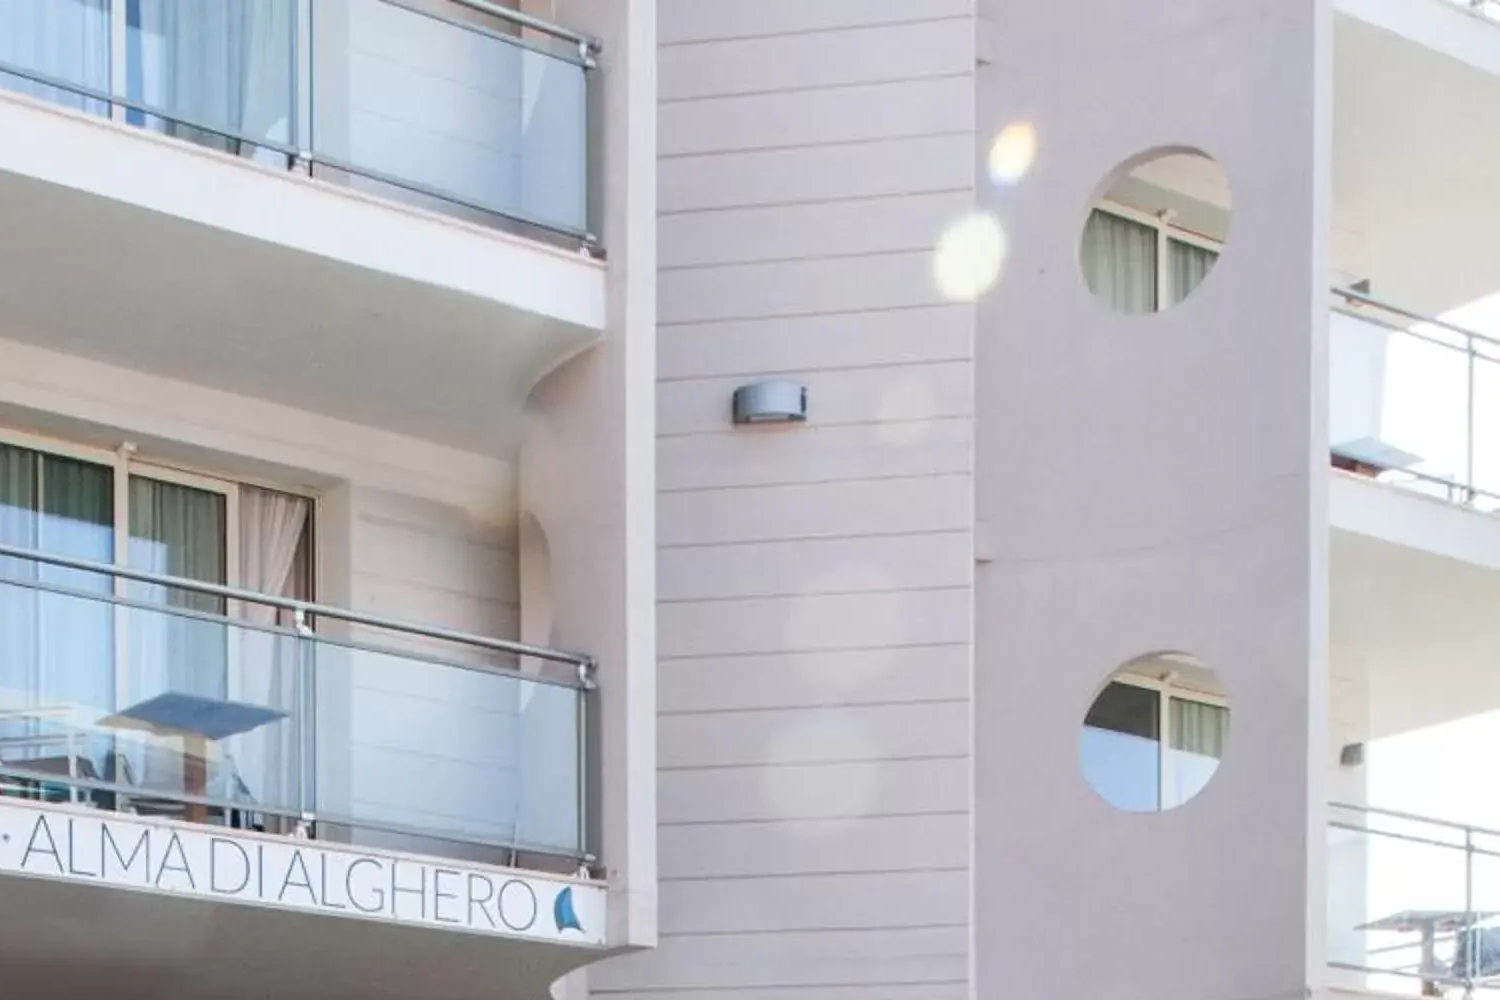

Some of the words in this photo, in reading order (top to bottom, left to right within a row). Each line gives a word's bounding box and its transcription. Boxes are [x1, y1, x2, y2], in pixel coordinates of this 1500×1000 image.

[20, 813, 196, 891] ALMA
[209, 838, 264, 898] DI
[278, 851, 538, 932] ALGHERO
